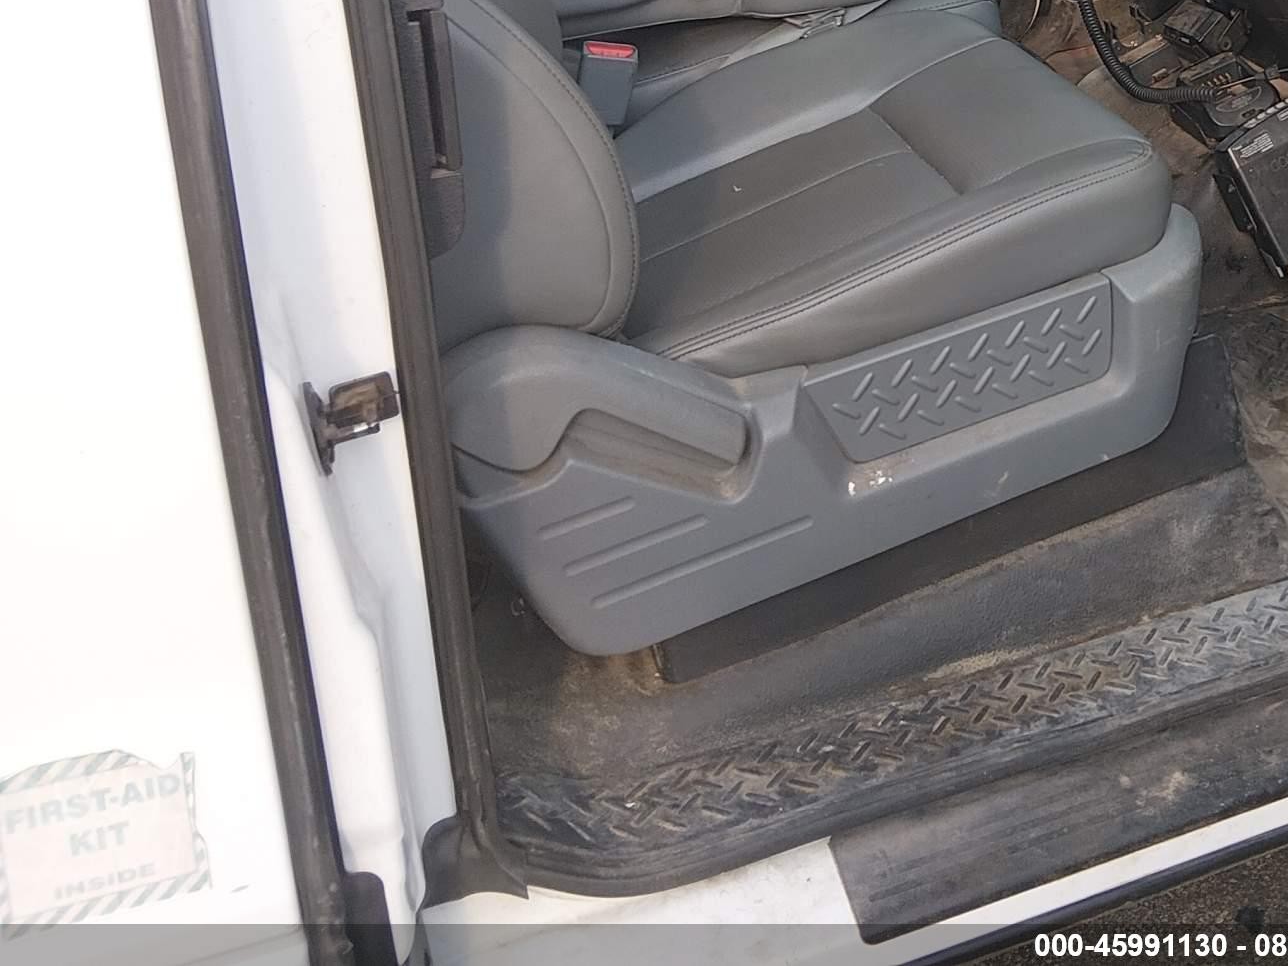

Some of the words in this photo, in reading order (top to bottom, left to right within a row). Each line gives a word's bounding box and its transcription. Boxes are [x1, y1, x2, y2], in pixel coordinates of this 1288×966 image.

[5, 775, 181, 835] FIRST-AID
[70, 821, 129, 856] KIT
[54, 863, 155, 900] INSIDE
